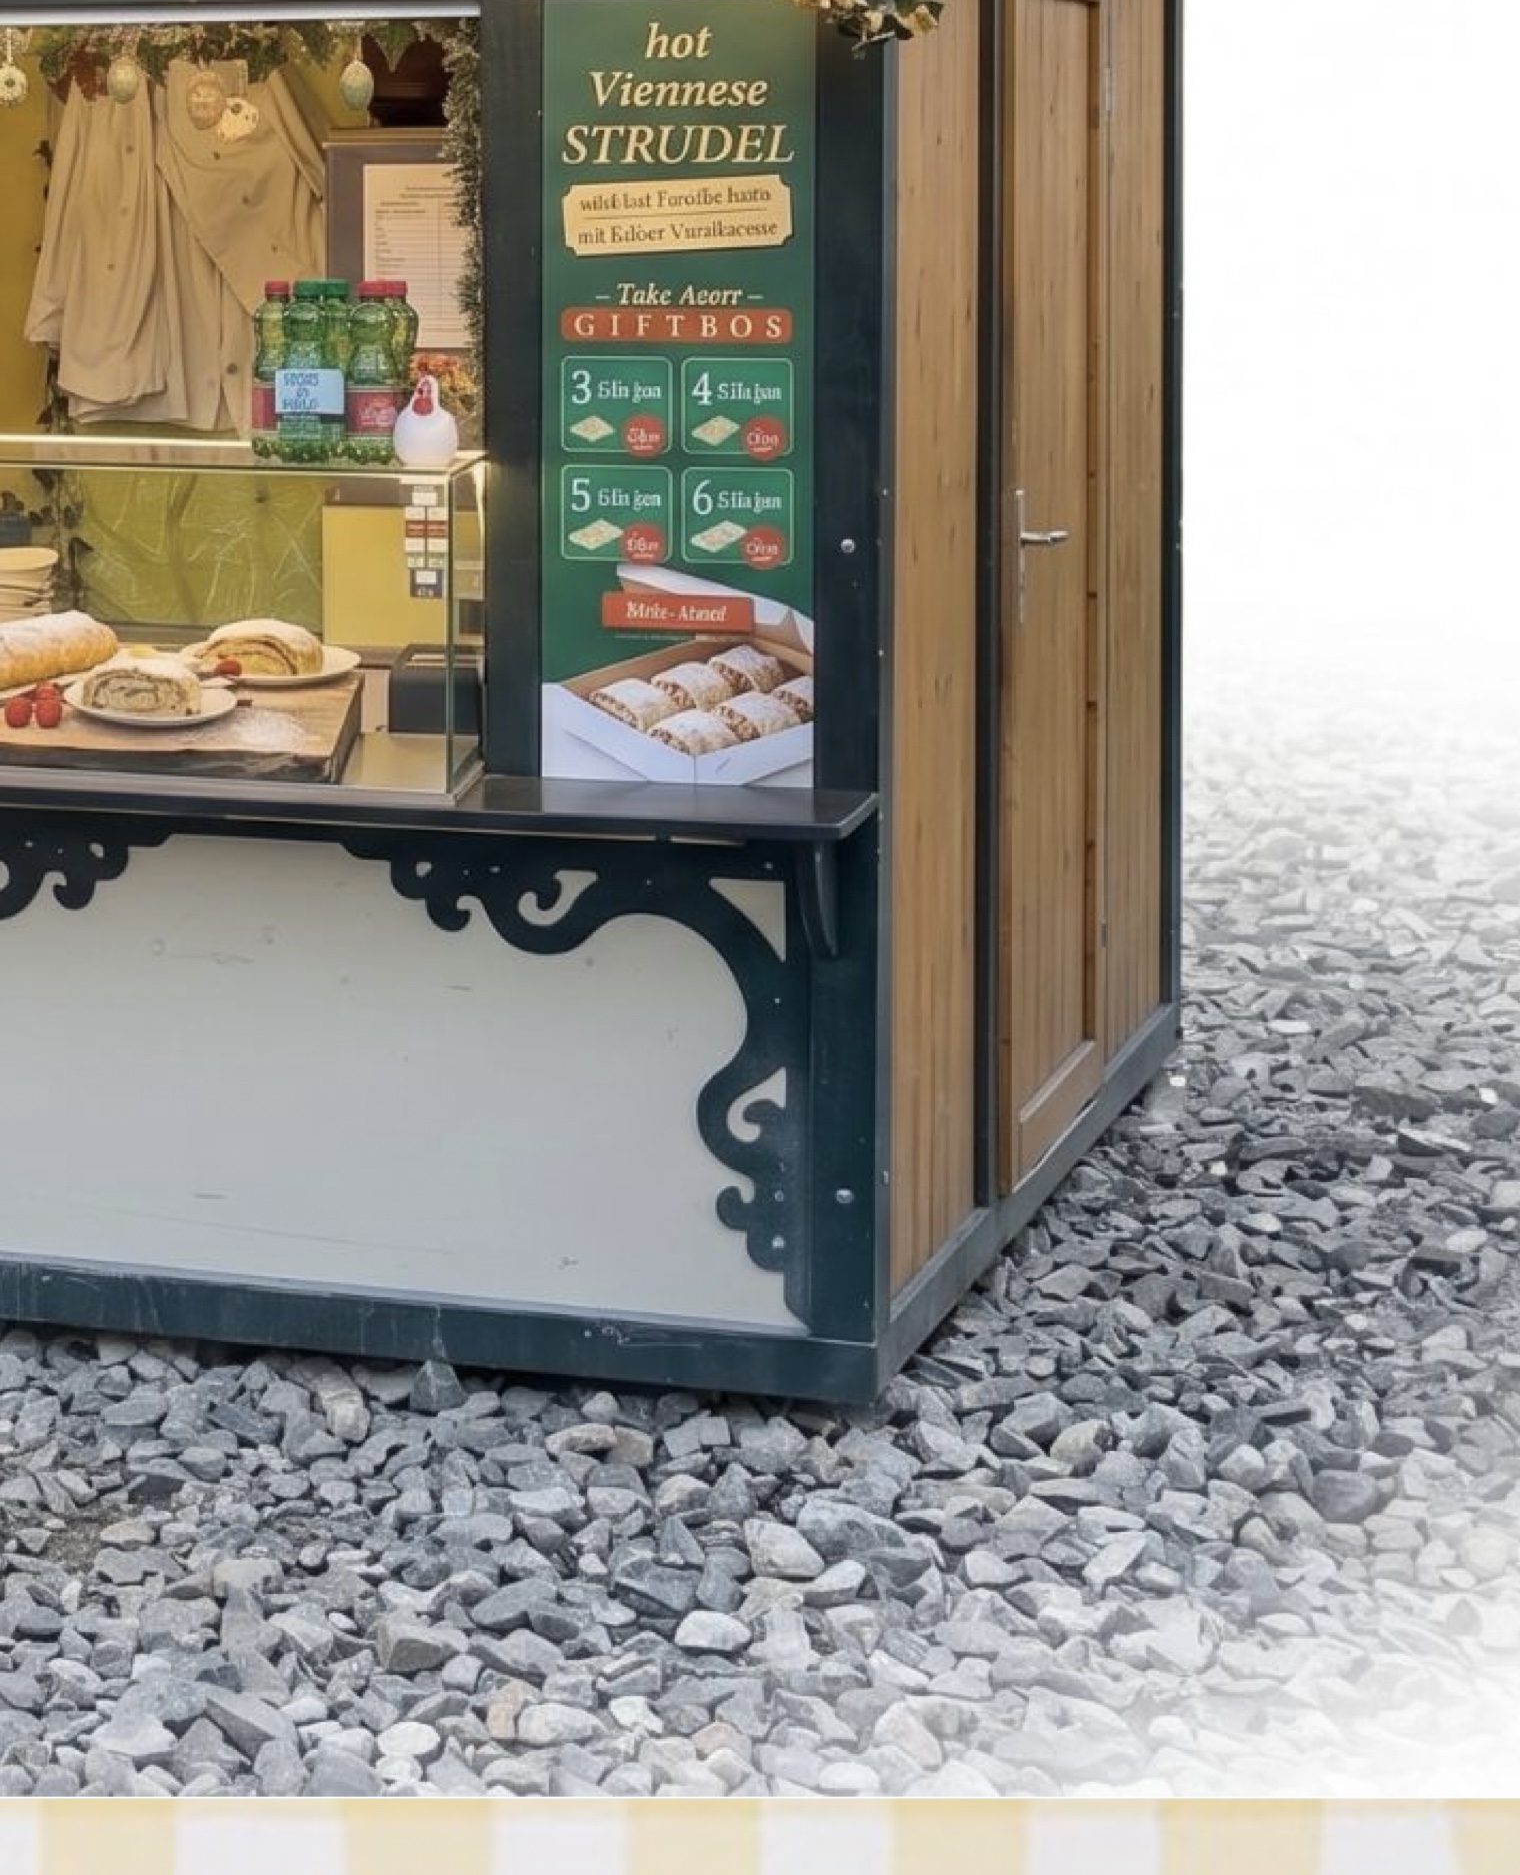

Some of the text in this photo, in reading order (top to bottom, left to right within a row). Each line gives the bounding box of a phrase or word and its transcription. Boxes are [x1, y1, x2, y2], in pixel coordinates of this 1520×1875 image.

[645, 23, 712, 59] hot
[589, 71, 768, 108] Viennese
[561, 125, 795, 165] STRUDEL
[571, 370, 592, 405] 3
[691, 371, 713, 406] 4
[571, 478, 591, 513] 5
[692, 479, 714, 516] 6
